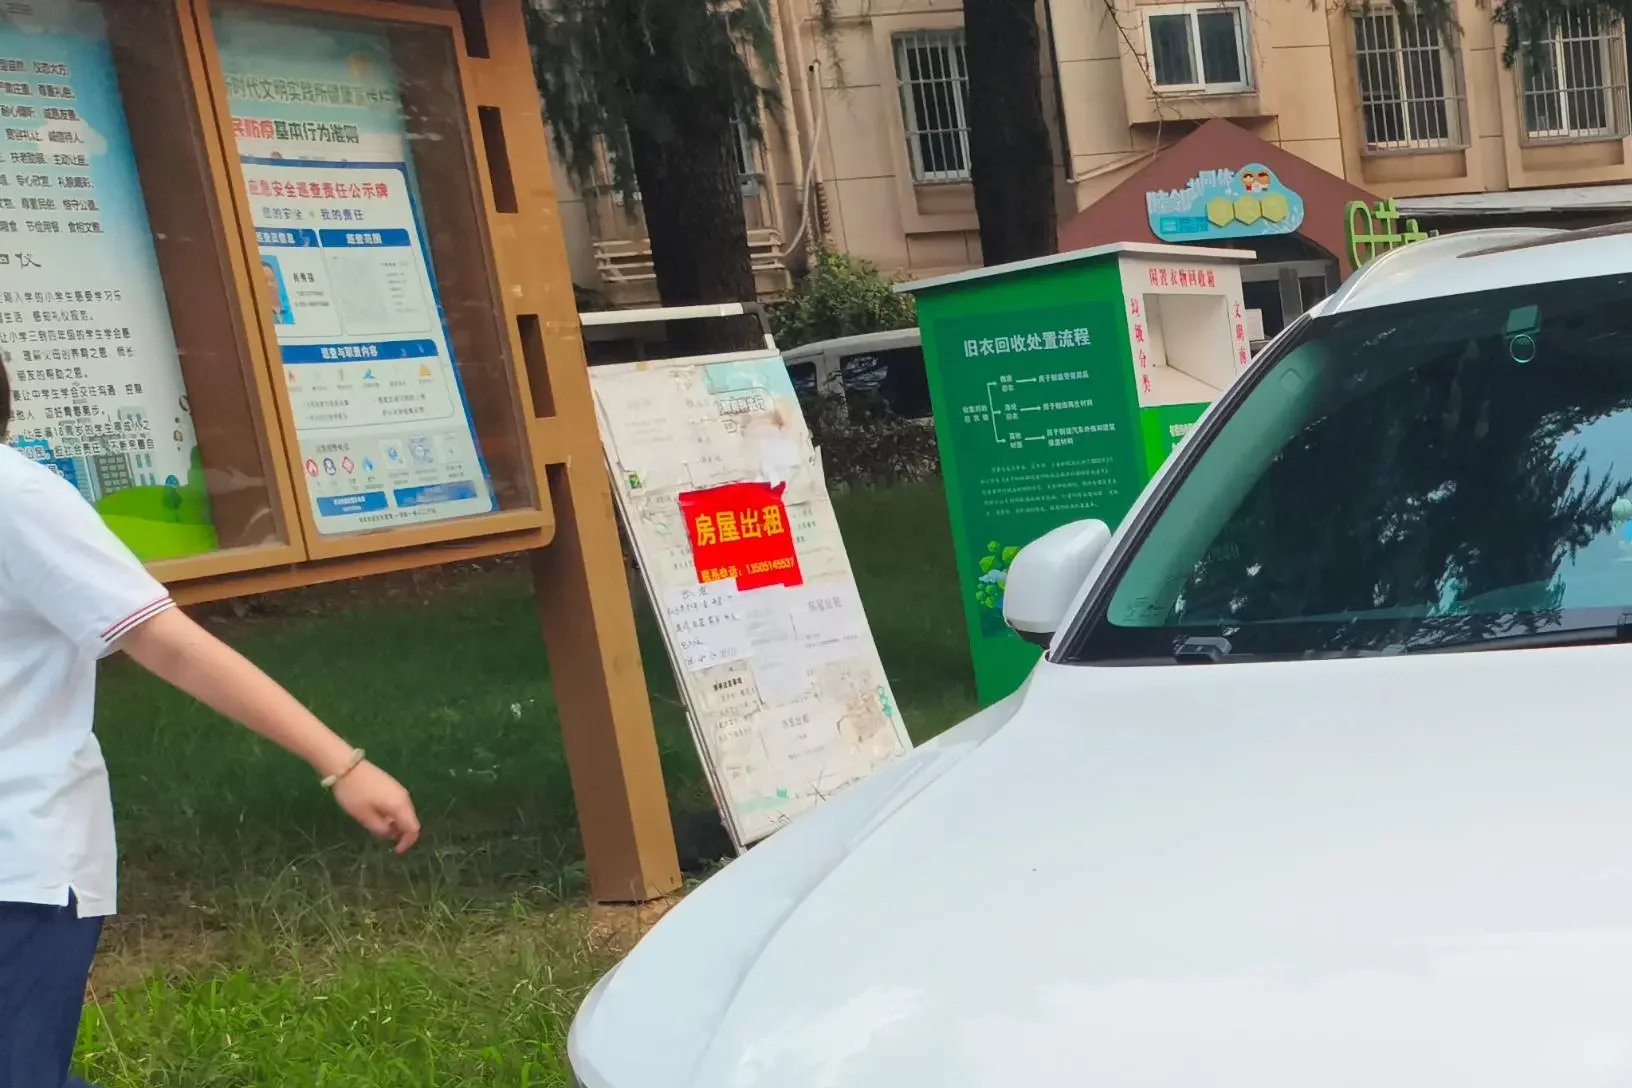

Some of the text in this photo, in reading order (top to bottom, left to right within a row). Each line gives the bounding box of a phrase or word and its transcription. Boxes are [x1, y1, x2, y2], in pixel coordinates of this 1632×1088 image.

[964, 327, 1091, 358] 旧衣回收处置流程
[695, 505, 785, 547] 房屋出租
